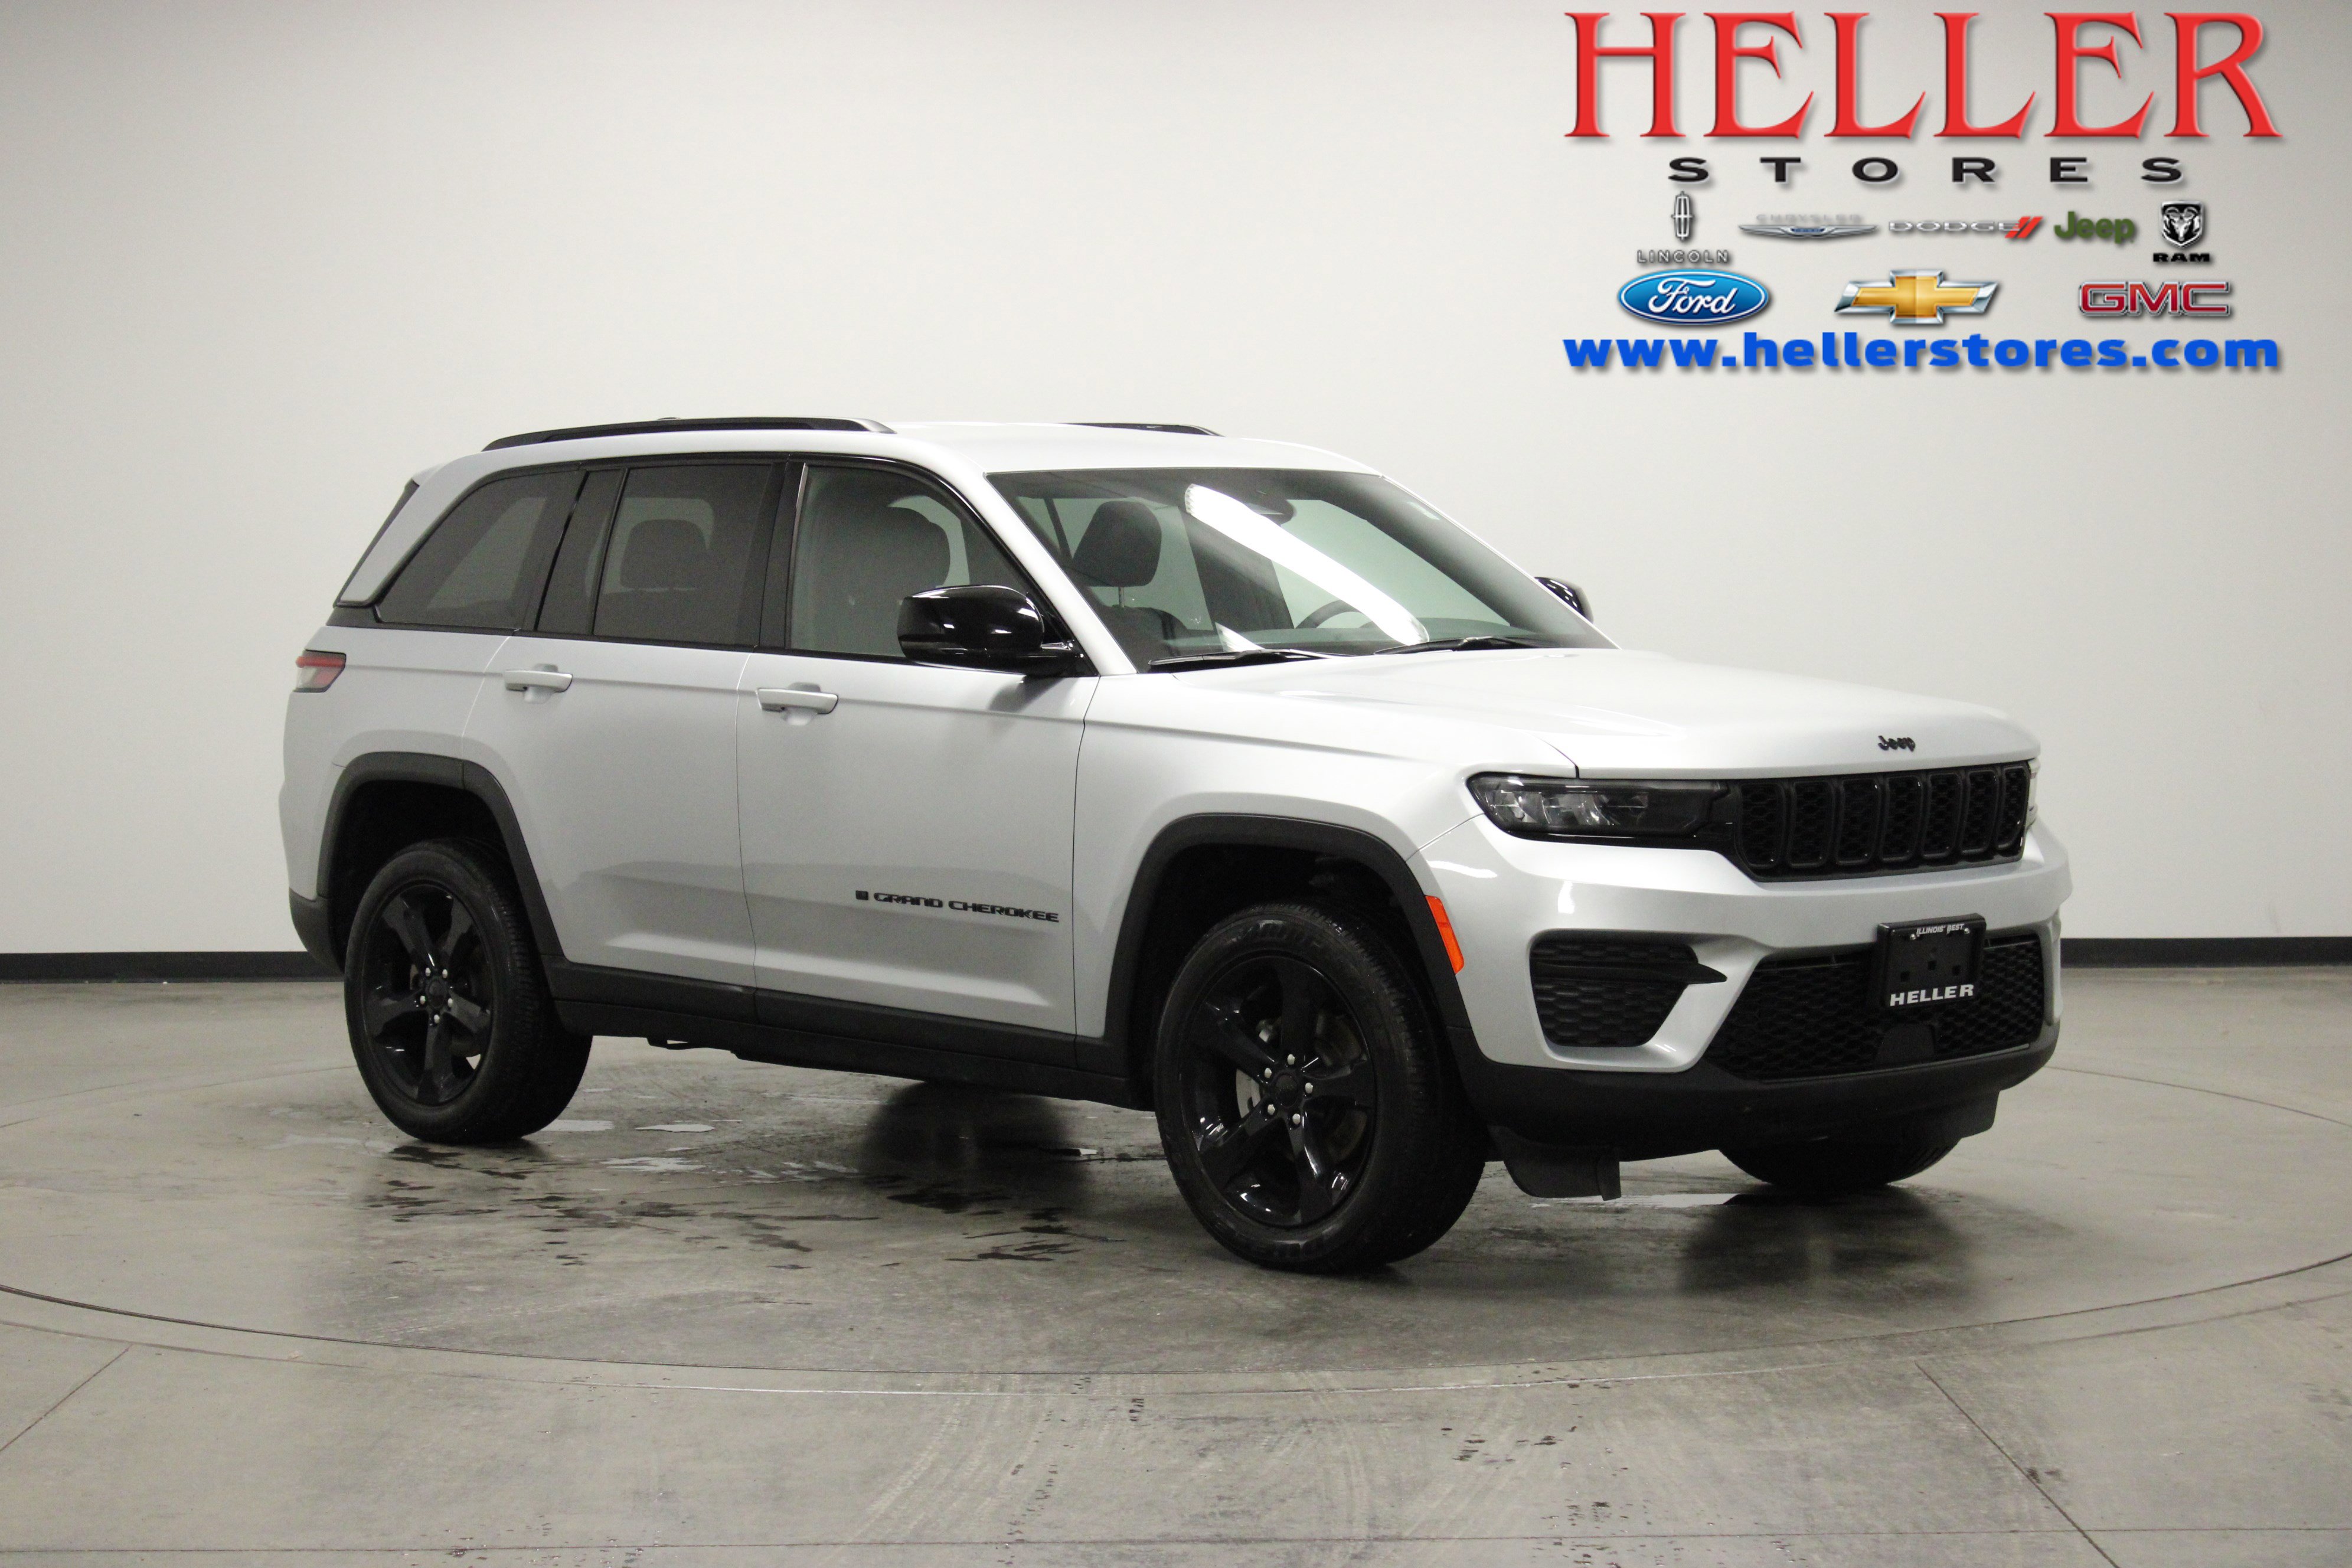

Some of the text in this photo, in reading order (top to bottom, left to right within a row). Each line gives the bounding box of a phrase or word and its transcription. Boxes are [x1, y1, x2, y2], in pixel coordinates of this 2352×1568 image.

[1878, 735, 1916, 752] Jeep
[873, 892, 1060, 923] GRAND CHEROKEE
[1946, 923, 1965, 935] BEST
[1890, 984, 1974, 1007] HELLER
